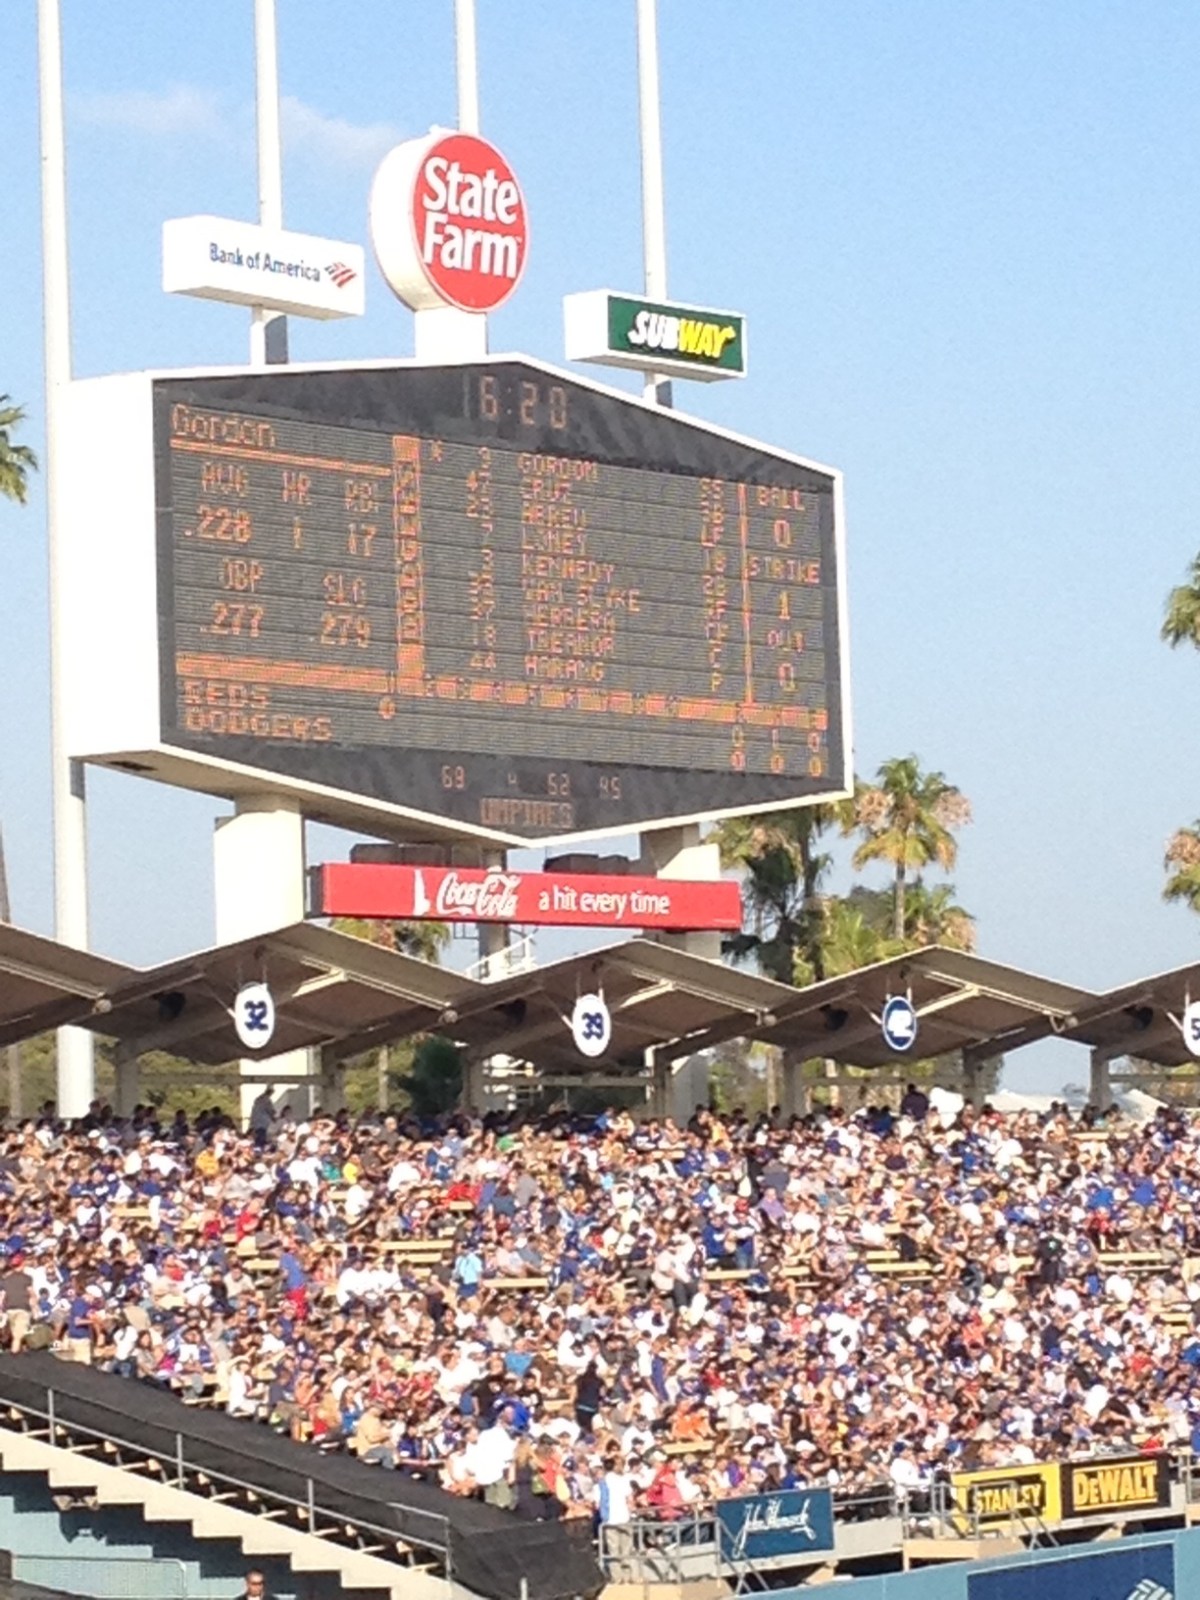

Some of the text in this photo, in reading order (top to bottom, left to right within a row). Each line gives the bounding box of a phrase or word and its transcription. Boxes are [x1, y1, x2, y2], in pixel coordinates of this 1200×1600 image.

[423, 156, 519, 224] State
[209, 243, 321, 283] Bank of America
[424, 212, 517, 279] Farm
[628, 311, 736, 357] SUBWAY
[171, 403, 276, 447] Gordon
[282, 471, 312, 506] HR
[538, 892, 549, 911] a
[553, 884, 578, 911] hit
[580, 894, 628, 920] every
[630, 890, 670, 915] time
[244, 1000, 269, 1031] 32
[581, 1012, 605, 1041] 39
